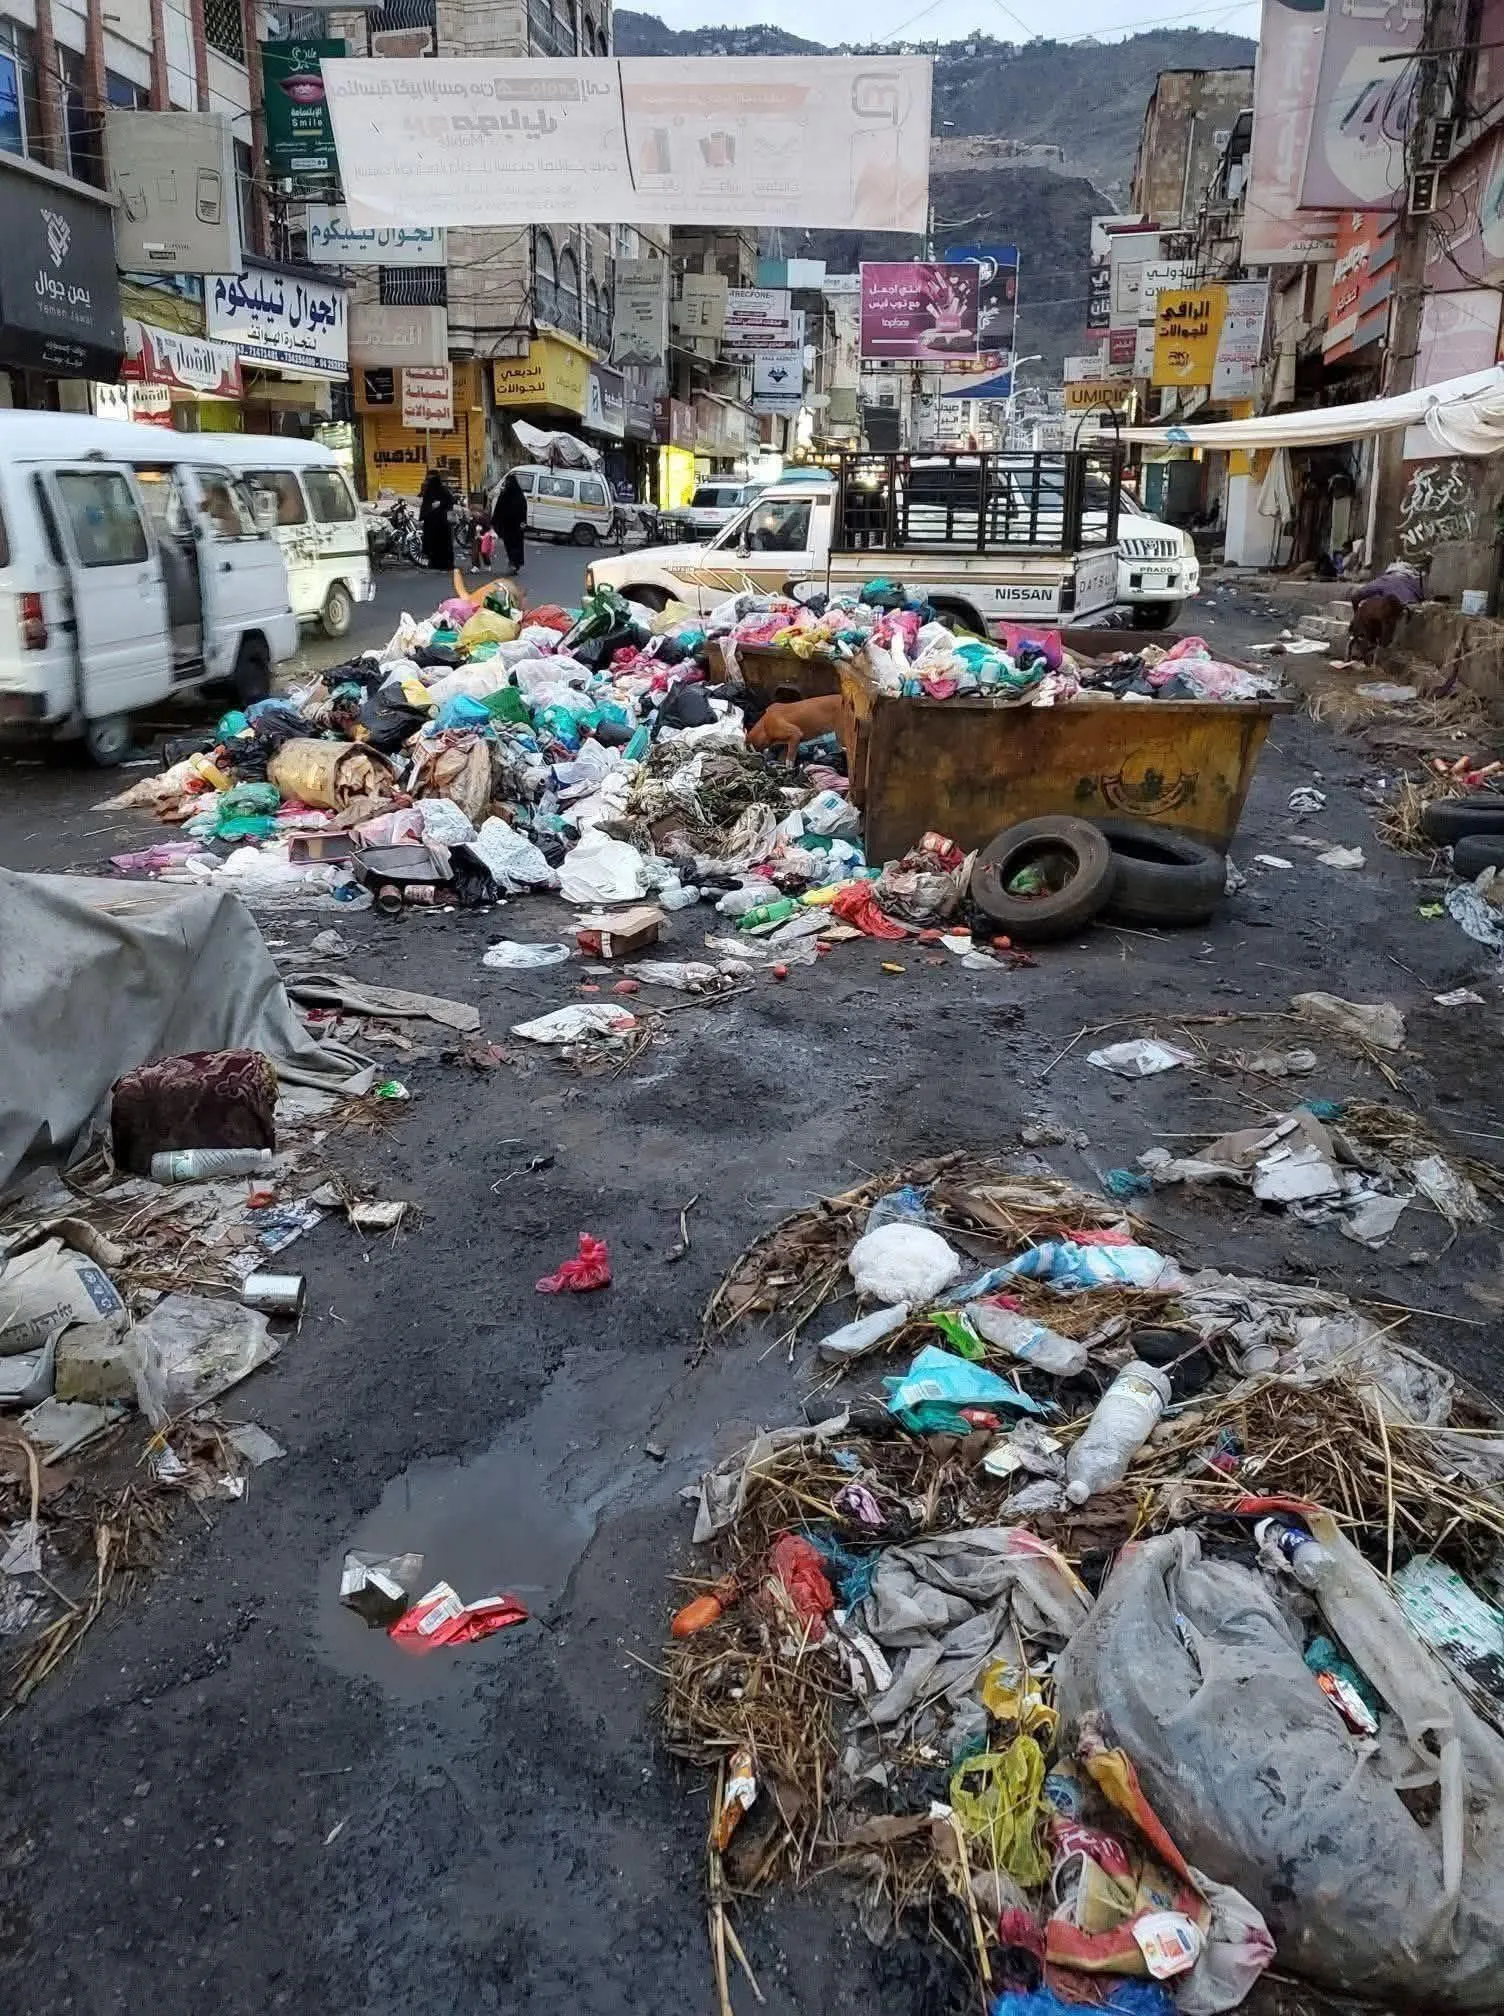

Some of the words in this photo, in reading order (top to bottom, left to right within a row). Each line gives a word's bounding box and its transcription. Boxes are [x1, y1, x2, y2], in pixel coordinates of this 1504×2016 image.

[291, 118, 323, 127] Smile
[34, 270, 65, 301] جوال
[67, 285, 91, 308] يمن
[215, 272, 284, 323] تيليكوم
[289, 285, 343, 334] الجوال
[1160, 301, 1209, 321] الراقي
[248, 326, 284, 346] الهواتف
[1159, 322, 1208, 338] للجوالات
[284, 331, 317, 352] لتجارة
[497, 382, 545, 394] للجوالات
[404, 402, 449, 421] الجوالات
[995, 588, 1053, 601] NISSAN
